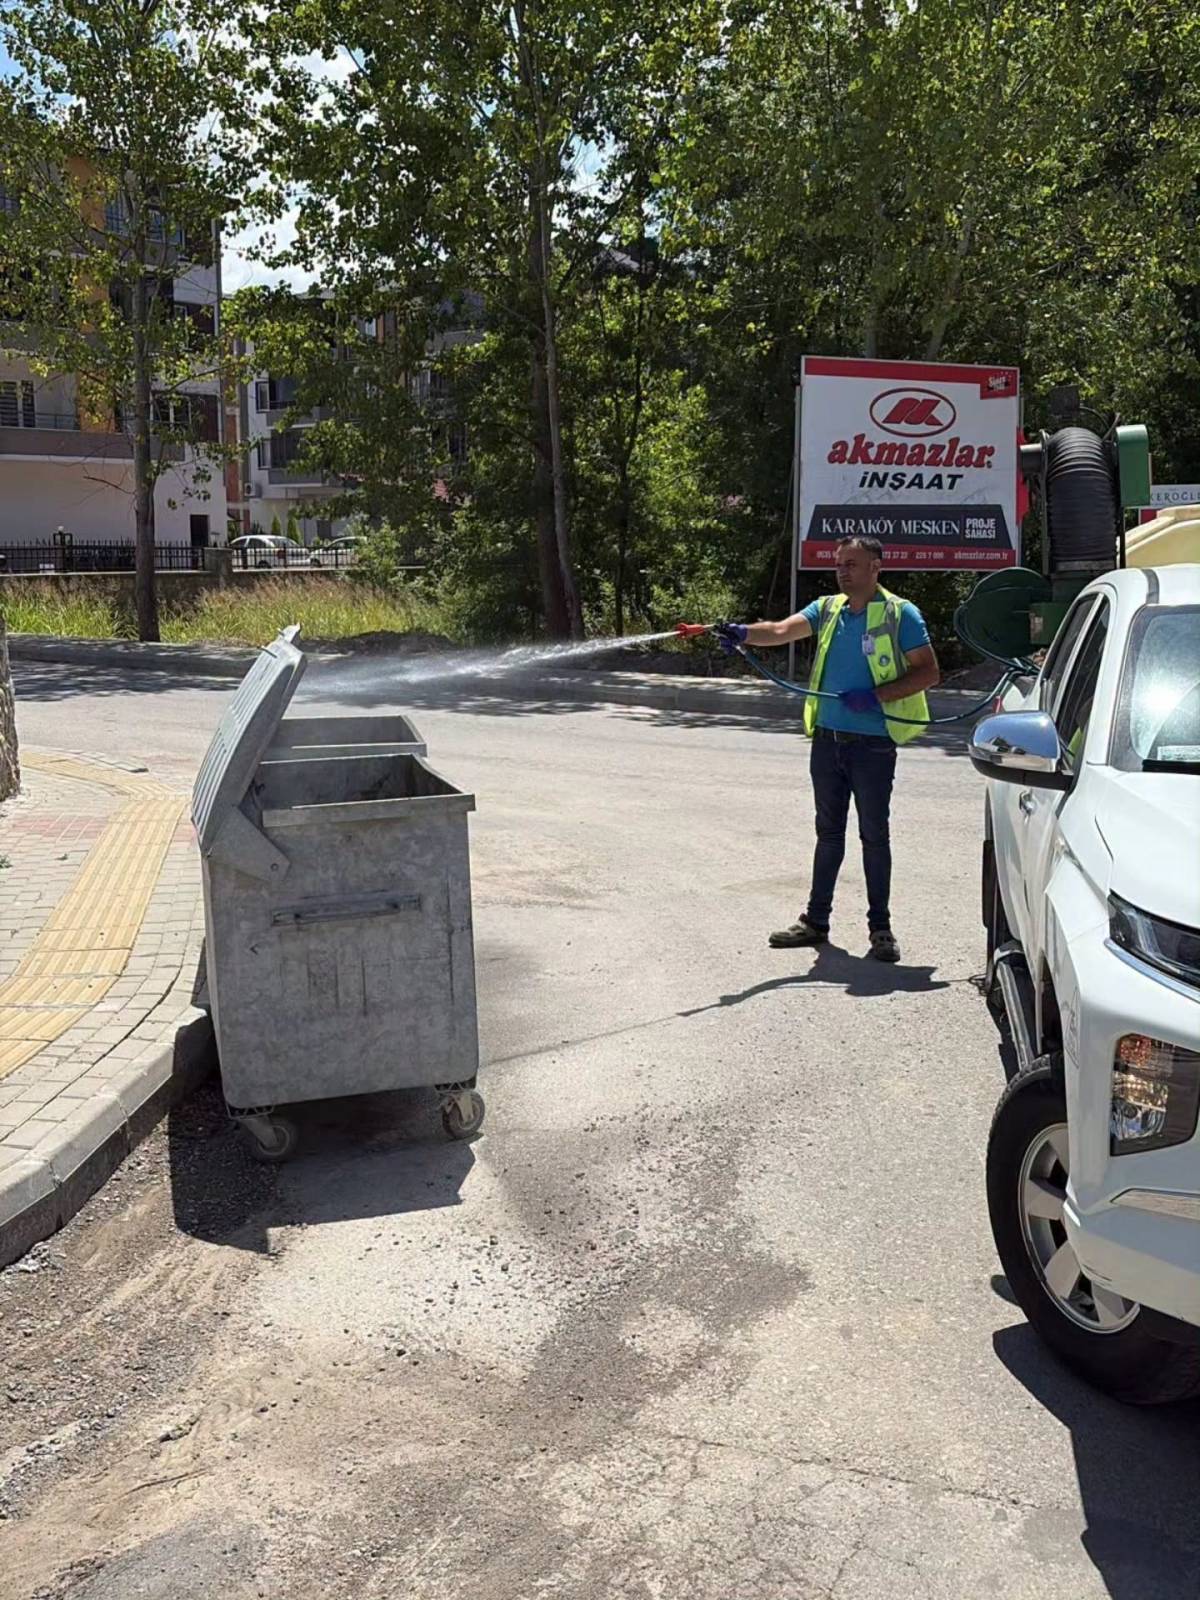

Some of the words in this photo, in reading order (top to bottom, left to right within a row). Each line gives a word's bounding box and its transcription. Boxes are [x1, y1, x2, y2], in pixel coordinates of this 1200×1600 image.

[821, 516, 897, 534] KARAKÖY
[900, 519, 960, 535] MESKEN
[966, 518, 996, 528] PROJE
[964, 528, 996, 539] SAHASI
